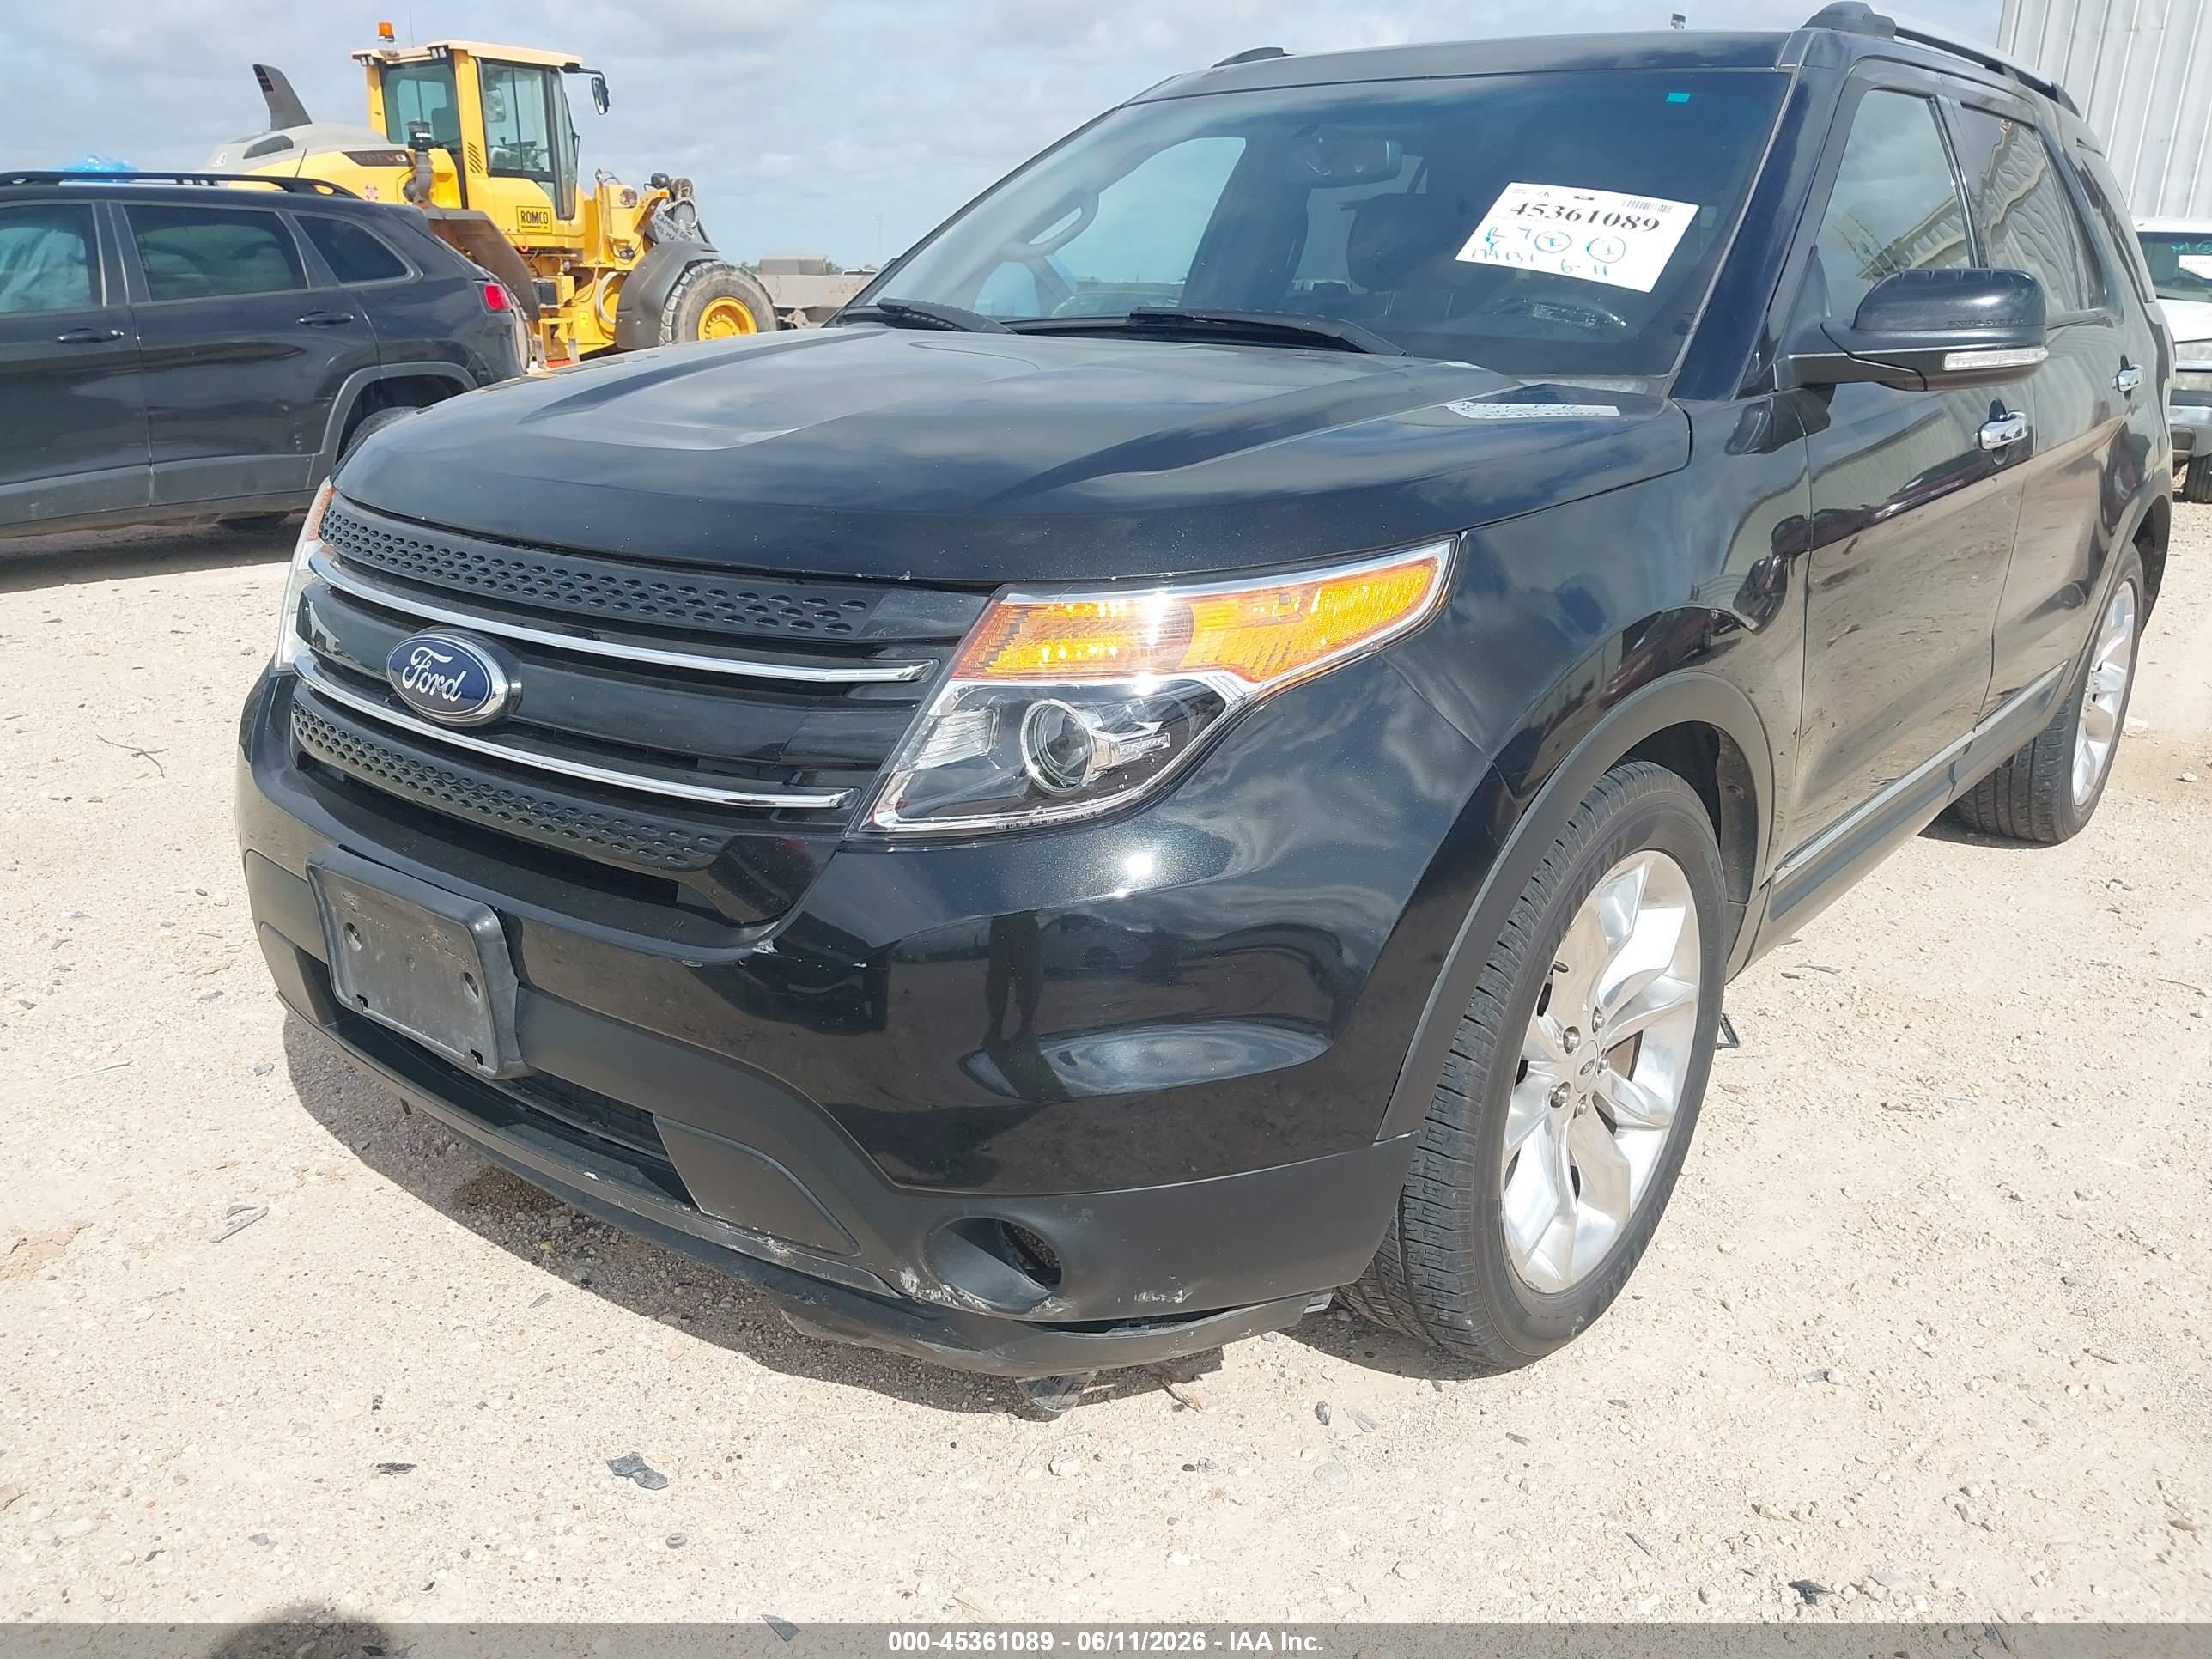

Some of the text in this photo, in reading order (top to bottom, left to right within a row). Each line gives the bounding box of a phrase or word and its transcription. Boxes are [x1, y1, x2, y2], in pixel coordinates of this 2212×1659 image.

[520, 210, 549, 225] ROMCO
[1510, 202, 1661, 233] 45361089
[402, 647, 467, 702] Ford
